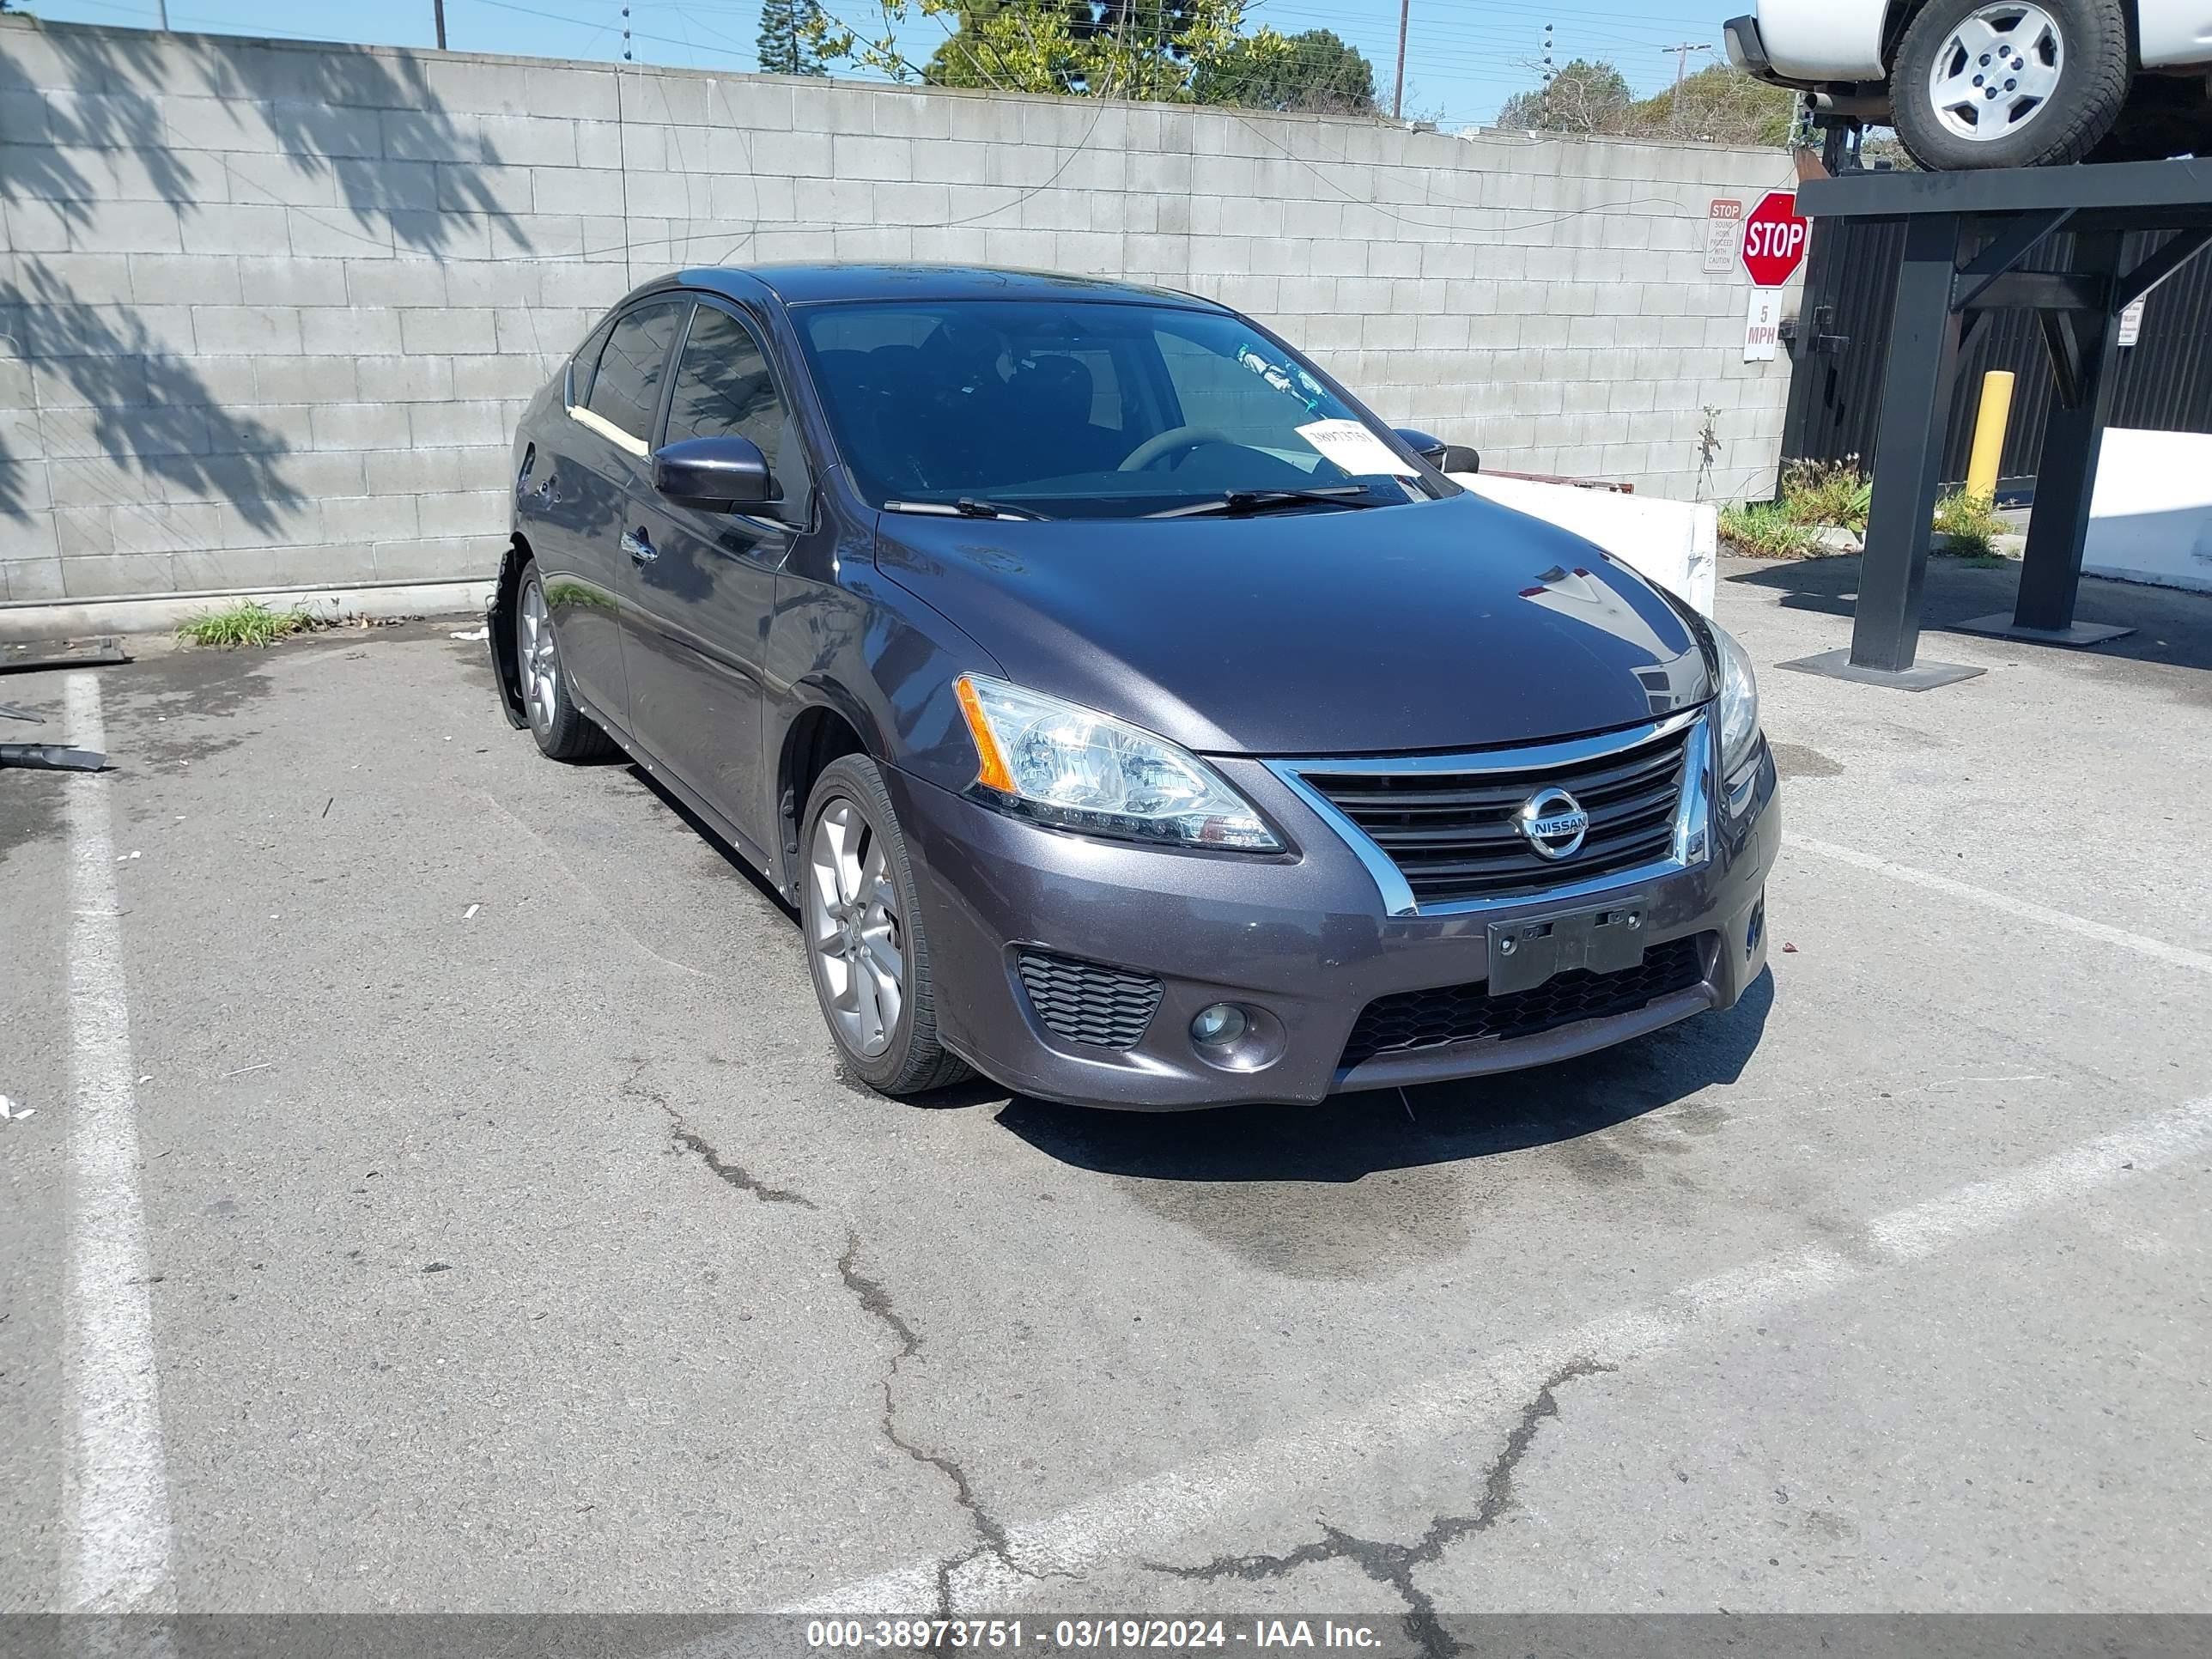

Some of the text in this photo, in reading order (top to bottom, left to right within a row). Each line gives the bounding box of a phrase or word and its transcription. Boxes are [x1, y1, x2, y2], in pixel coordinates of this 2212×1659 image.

[1712, 204, 1740, 217] STOP
[1746, 221, 1803, 258] STOP
[1760, 305, 1769, 323] 5
[1747, 326, 1776, 344] MPH
[1534, 817, 1586, 834] NISSAN
